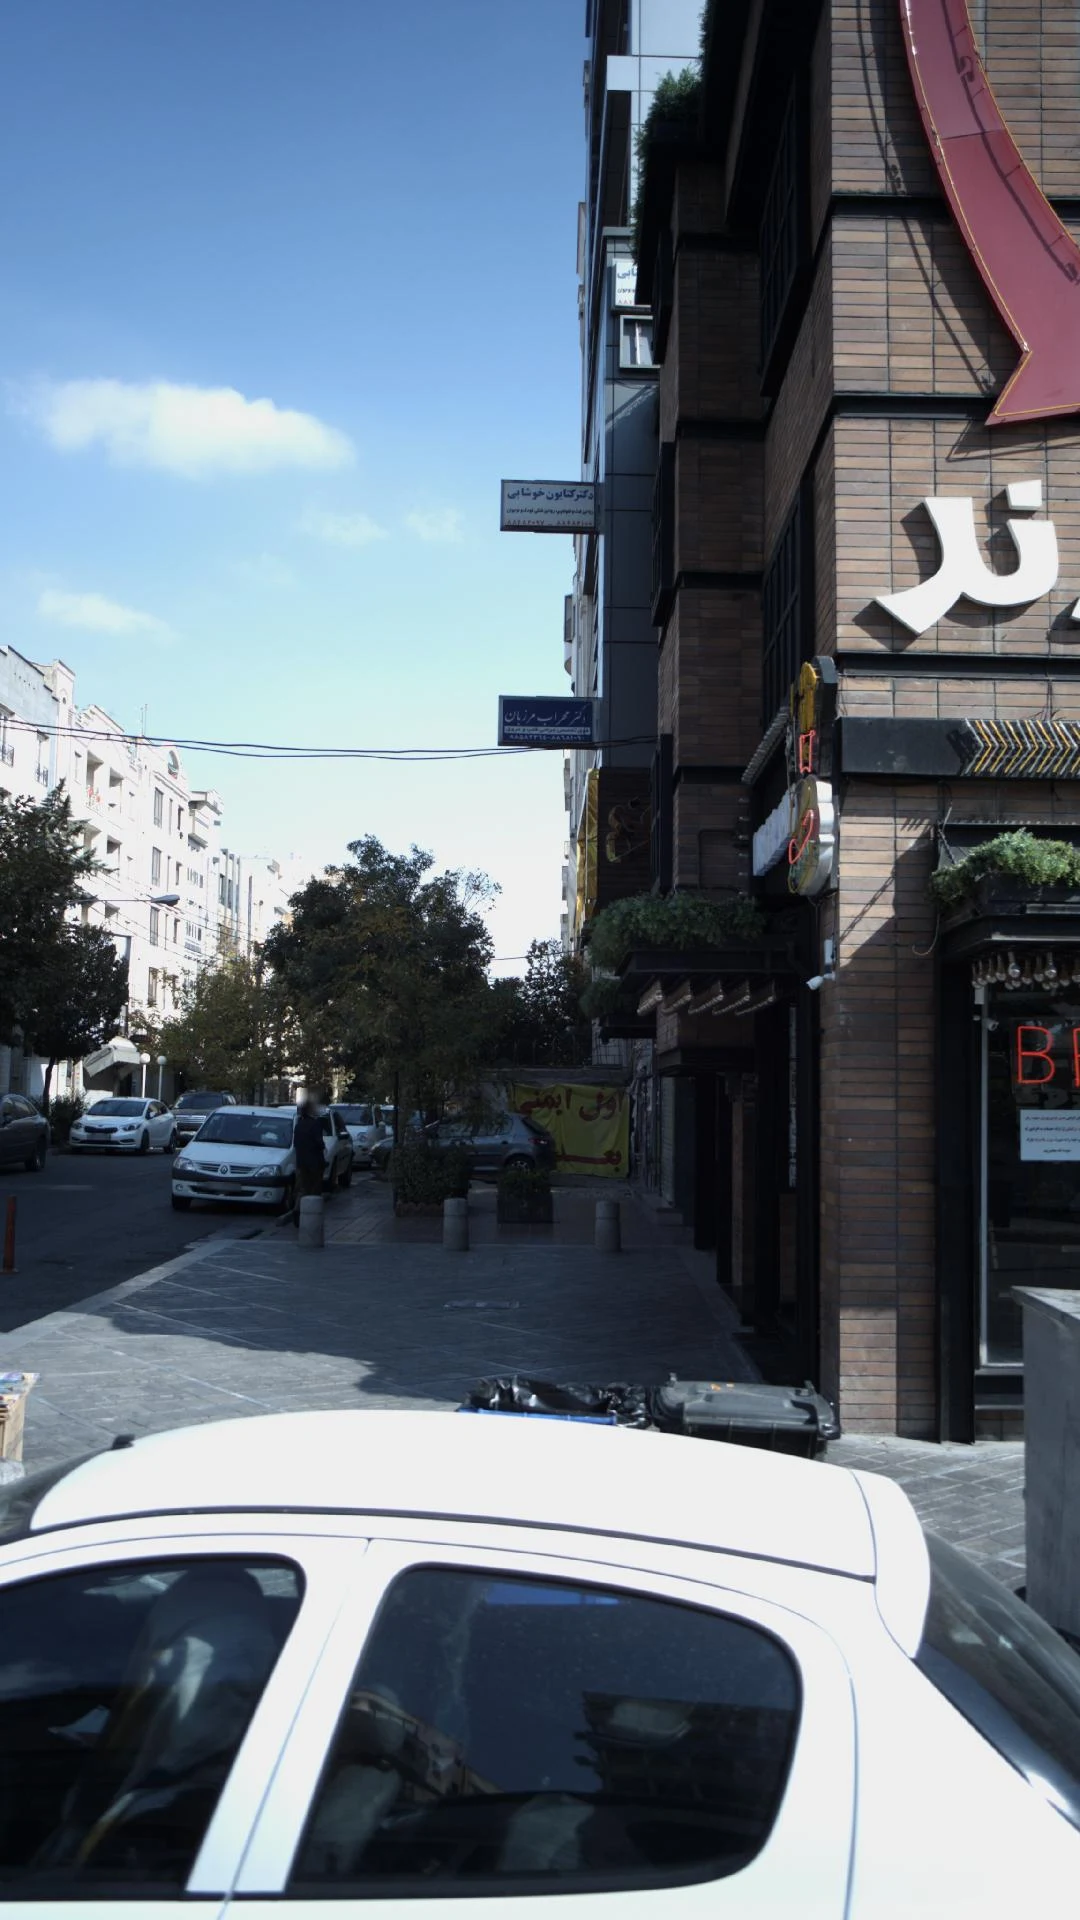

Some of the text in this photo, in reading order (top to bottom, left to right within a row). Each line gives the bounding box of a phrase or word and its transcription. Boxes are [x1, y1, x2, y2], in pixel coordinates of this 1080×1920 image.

[507, 487, 594, 502] دکتر کتایون خوشابی
[504, 708, 536, 726] مرزبان
[569, 704, 590, 726] دکتر
